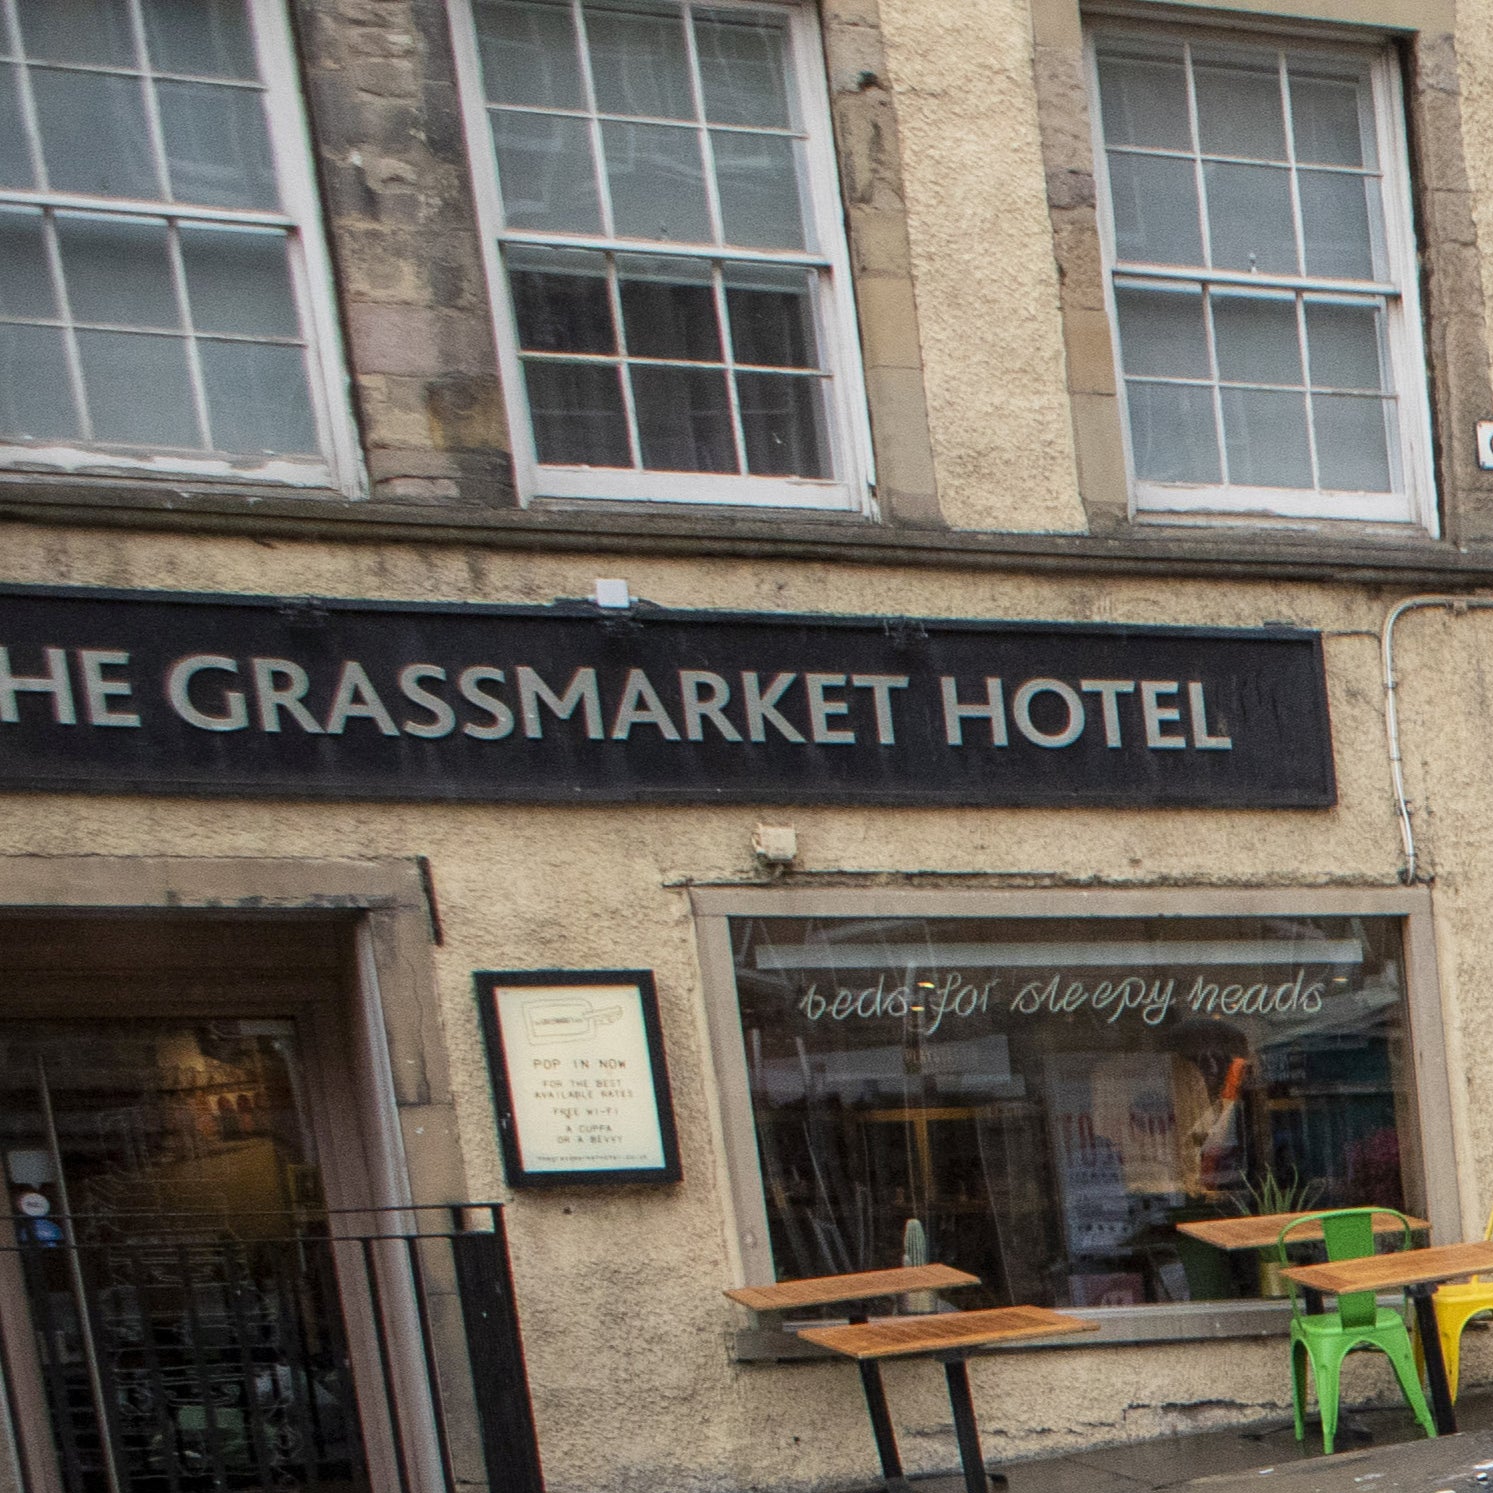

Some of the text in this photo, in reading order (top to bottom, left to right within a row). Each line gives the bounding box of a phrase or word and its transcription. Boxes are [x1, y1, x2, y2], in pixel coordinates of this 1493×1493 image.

[167, 653, 909, 747] GRASSMARKET
[940, 676, 1233, 751] HOTEL
[800, 968, 1326, 1037] beds for sleepy heads
[532, 1058, 627, 1071] POP IN NOW
